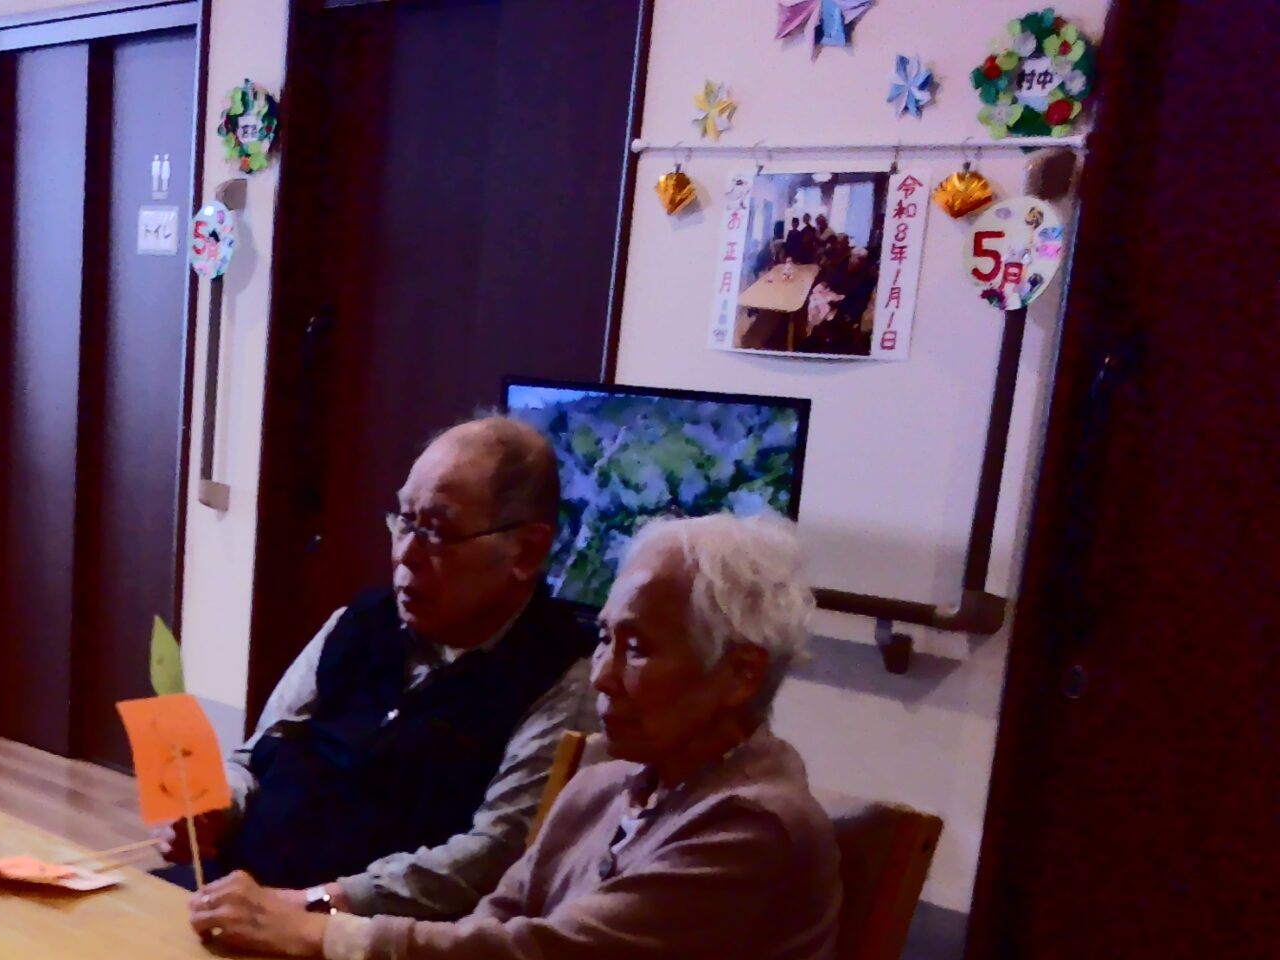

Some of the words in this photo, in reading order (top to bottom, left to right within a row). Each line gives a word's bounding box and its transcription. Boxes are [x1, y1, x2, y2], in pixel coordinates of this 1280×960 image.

[880, 174, 924, 351] 令和8年1月1日
